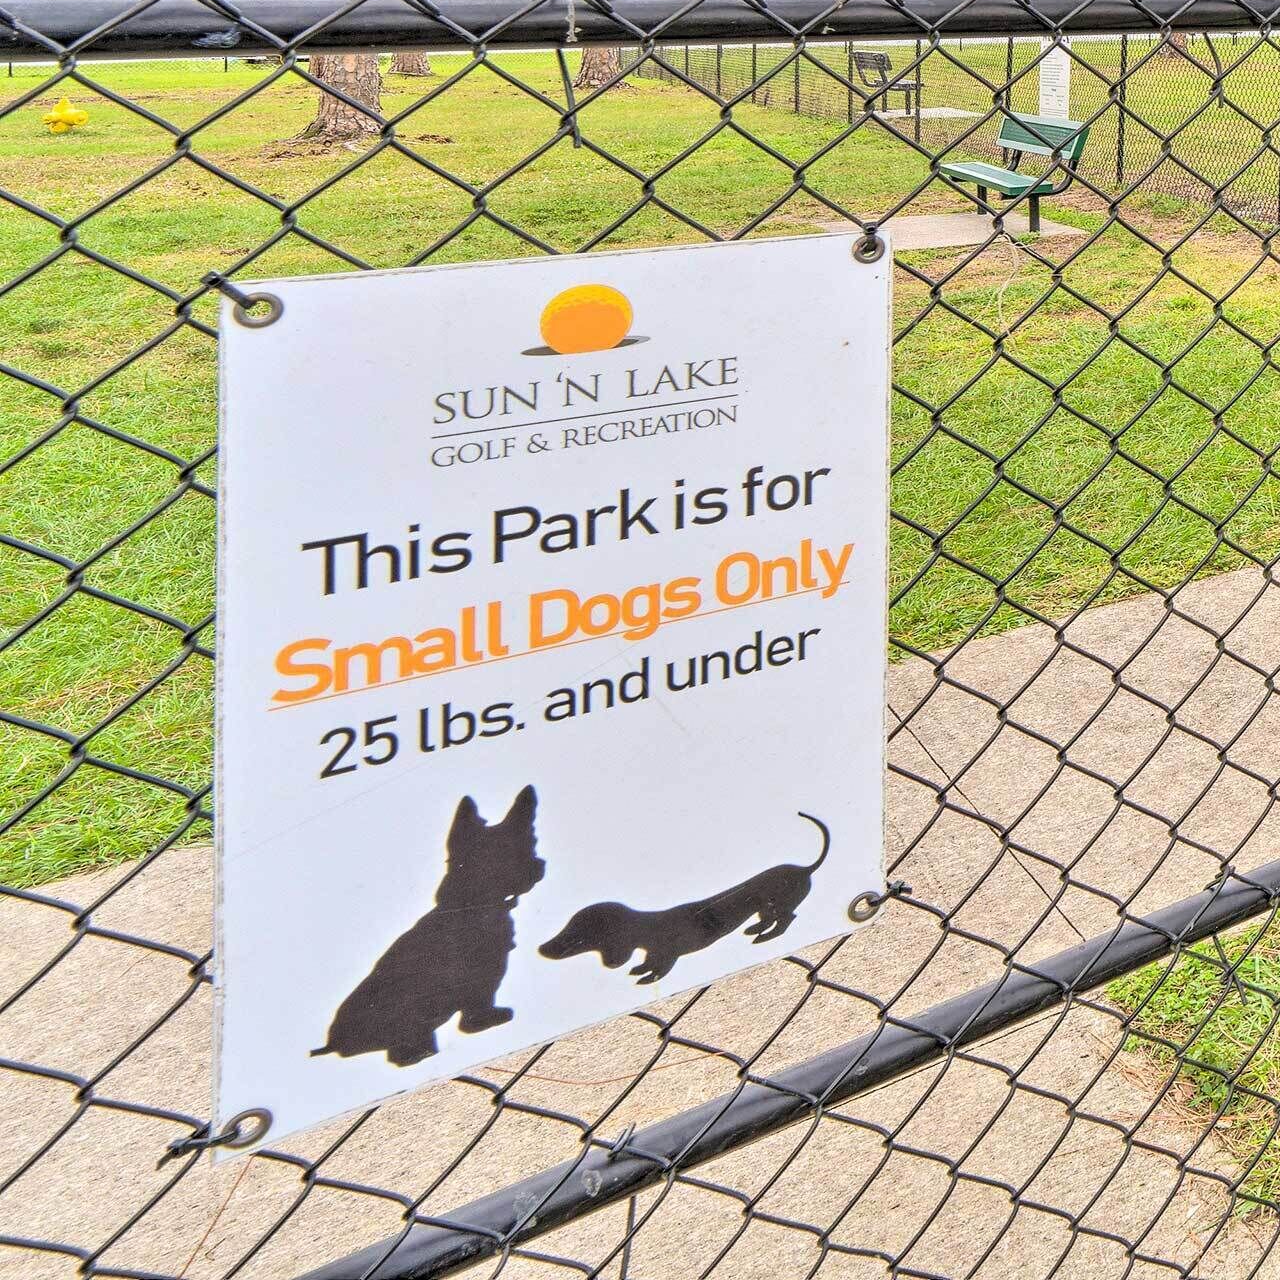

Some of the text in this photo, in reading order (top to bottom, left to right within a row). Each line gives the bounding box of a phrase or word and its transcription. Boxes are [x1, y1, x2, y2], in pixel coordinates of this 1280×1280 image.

[430, 403, 740, 468] GOLF & RECREATION
[433, 378, 541, 427] SUN
[624, 353, 741, 400] LAKE
[301, 465, 831, 597] This Park is for
[271, 538, 855, 707] Small Dogs Only
[318, 625, 822, 781] 25 lbs. and under
